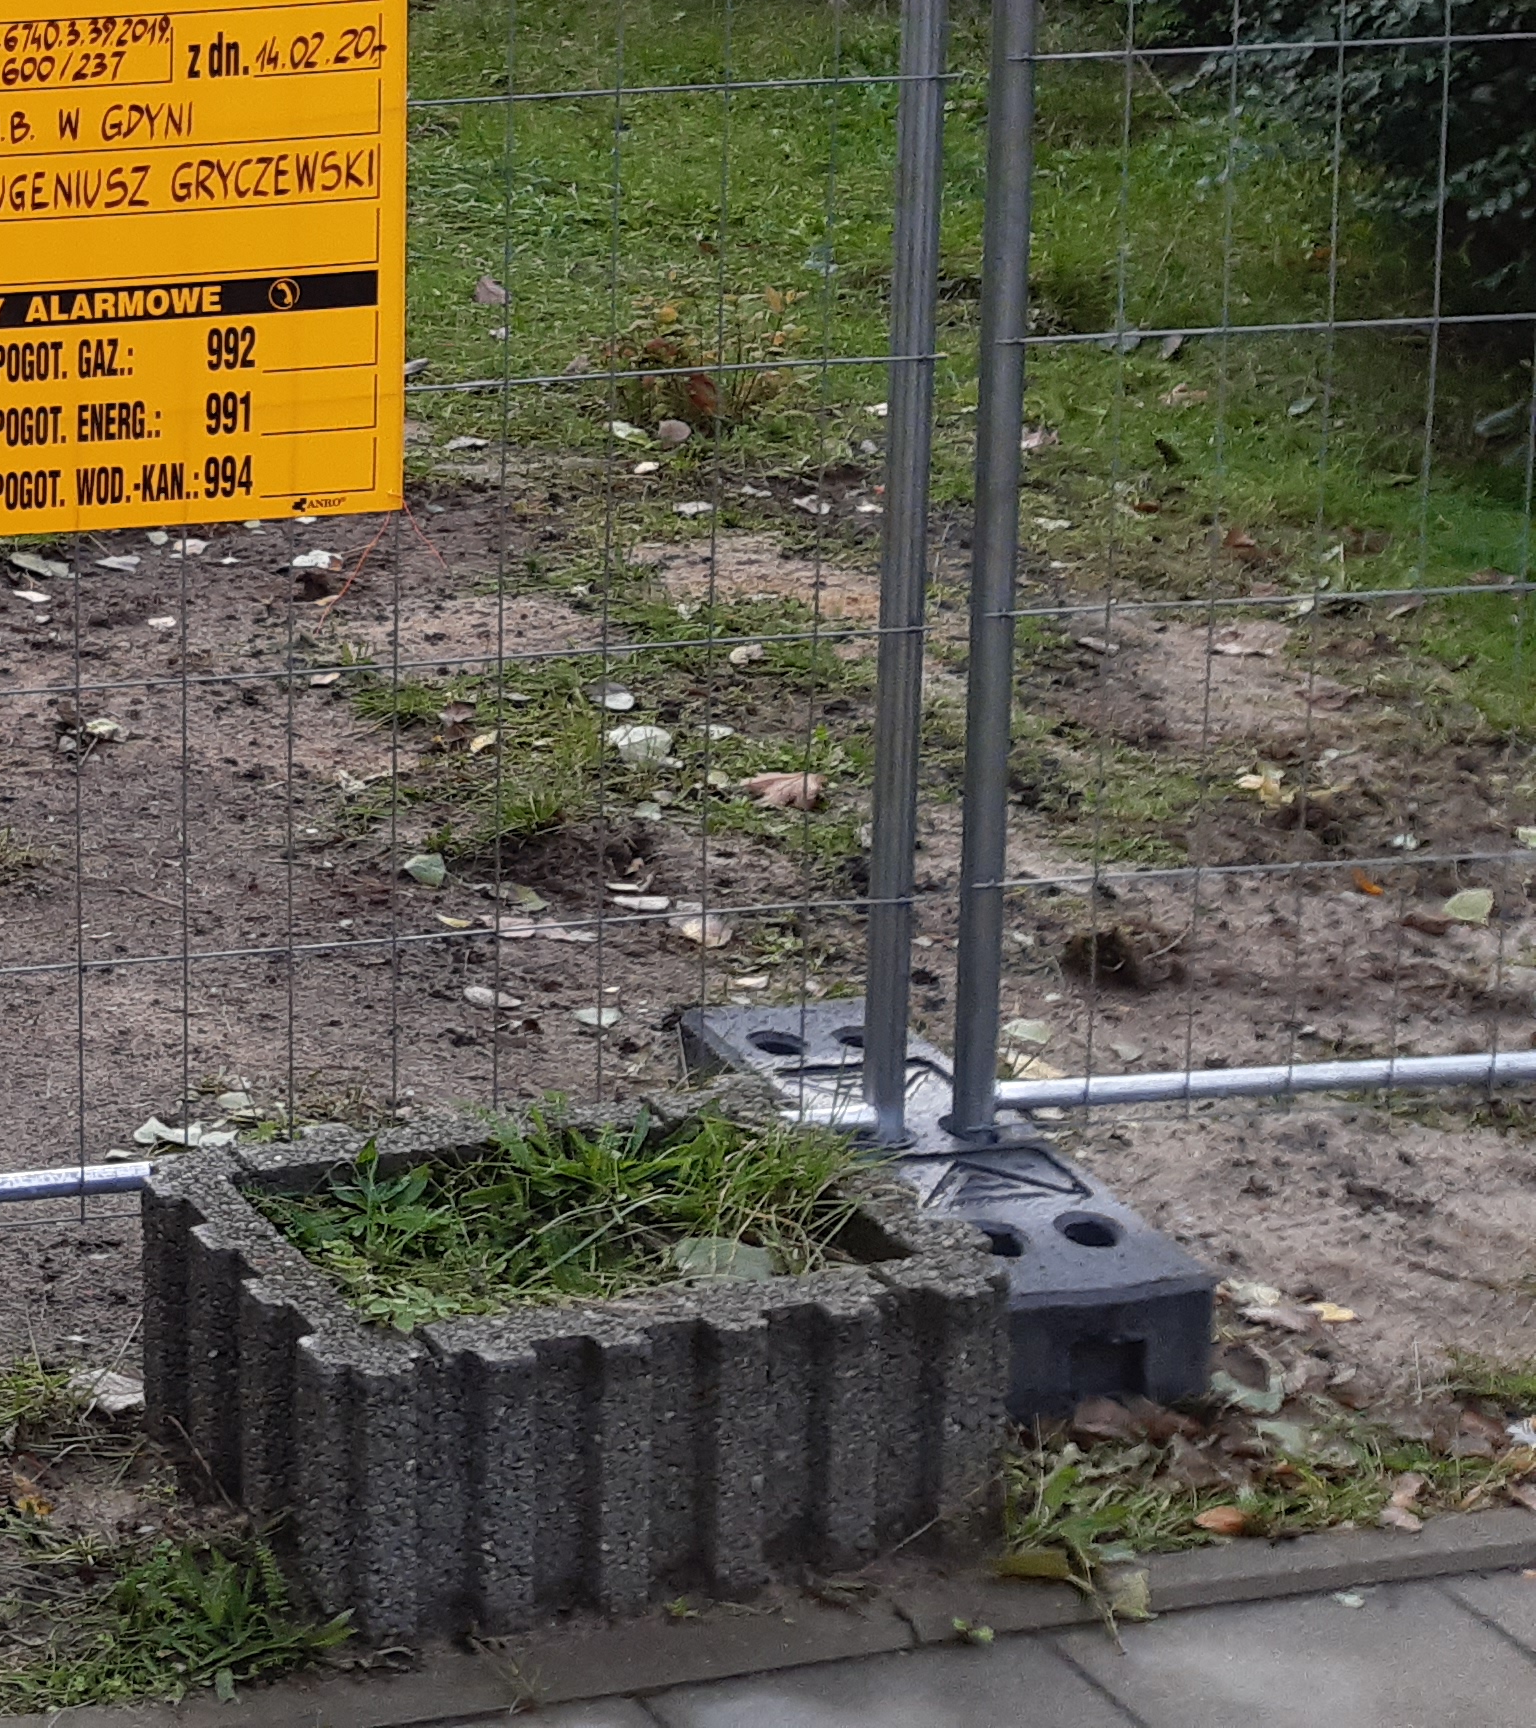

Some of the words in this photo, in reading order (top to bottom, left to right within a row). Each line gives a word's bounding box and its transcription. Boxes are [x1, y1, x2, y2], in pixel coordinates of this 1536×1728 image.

[188, 45, 201, 79] z
[210, 32, 248, 76] dn.
[58, 108, 81, 140] W
[101, 102, 194, 140] GDYNI
[171, 148, 376, 204] GRYCZEWSKI
[25, 286, 222, 324] ALARMOWE
[79, 337, 133, 377] GAZ.:
[207, 326, 256, 371] 992
[78, 400, 160, 442] ENERG.:
[206, 391, 252, 435] 991
[204, 454, 252, 497] 994
